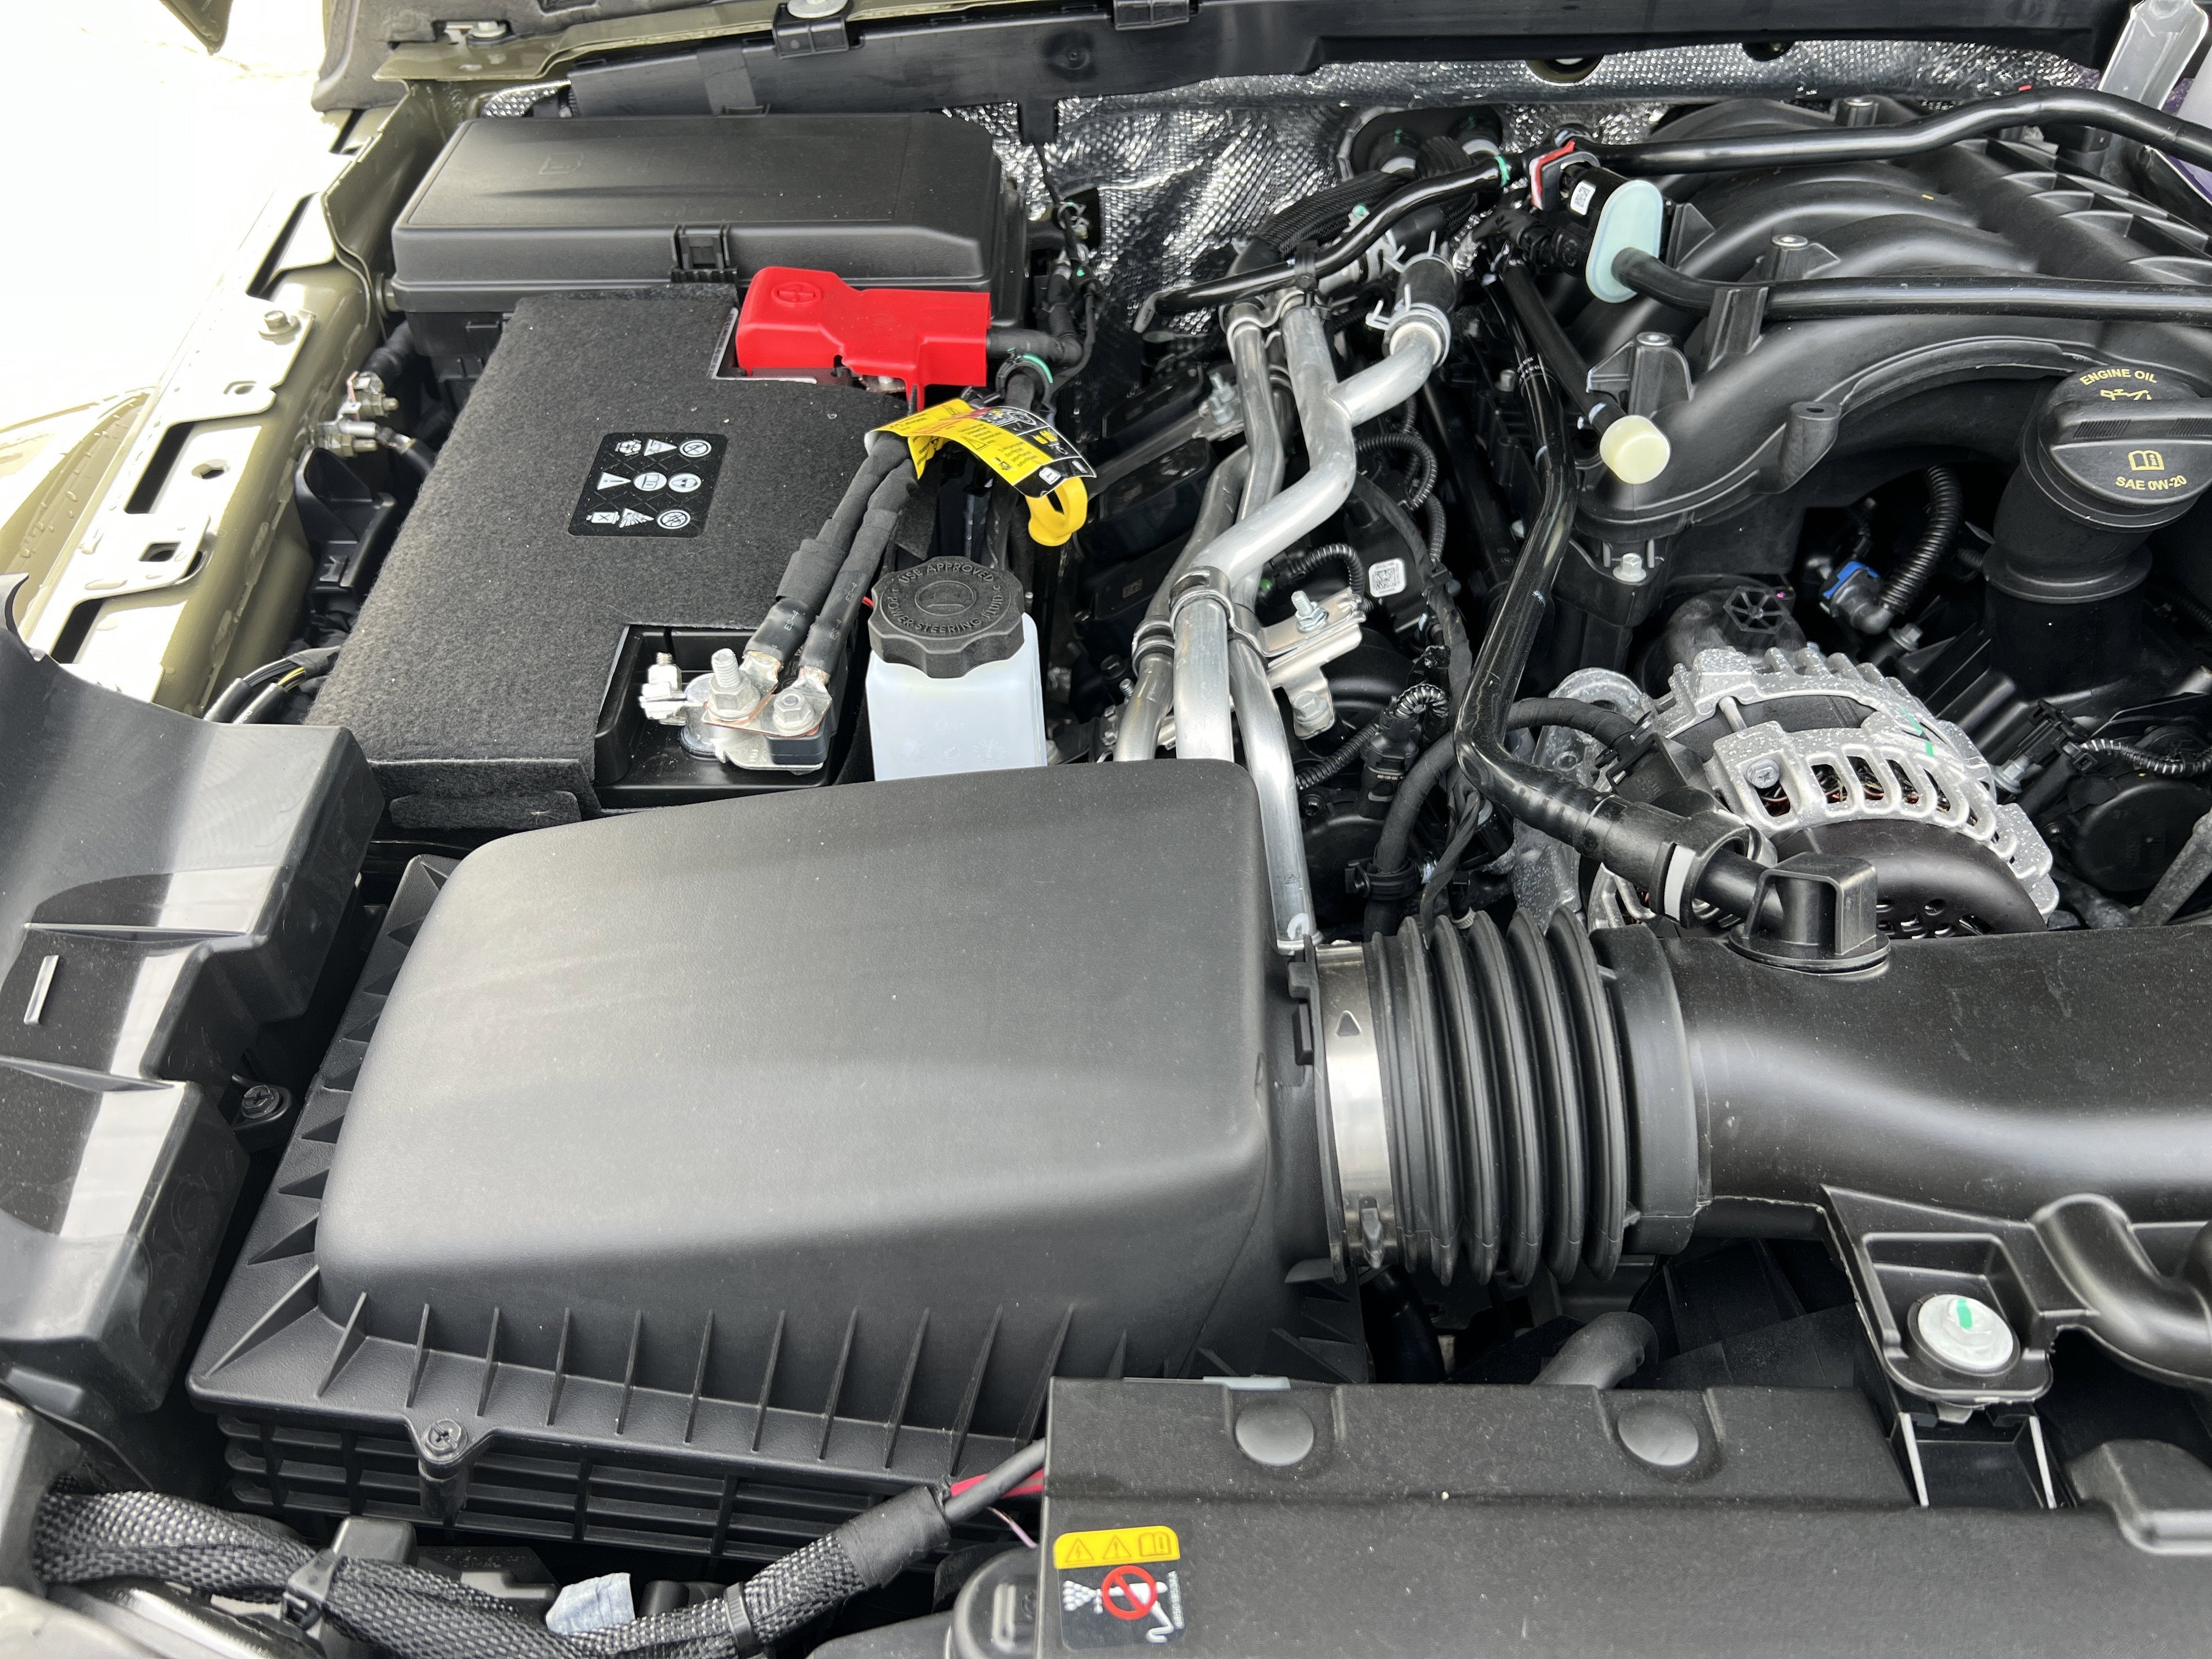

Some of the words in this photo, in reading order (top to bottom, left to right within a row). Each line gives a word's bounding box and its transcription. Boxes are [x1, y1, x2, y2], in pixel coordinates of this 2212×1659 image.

[2079, 368, 2131, 386] ENGINE
[2134, 370, 2158, 384] OIL
[2115, 476, 2145, 490] SAE
[2147, 475, 2187, 491] 0W-20
[898, 567, 924, 584] USE
[926, 562, 994, 583] APPROVED
[887, 596, 914, 628] POWER
[915, 617, 983, 635] STEERING
